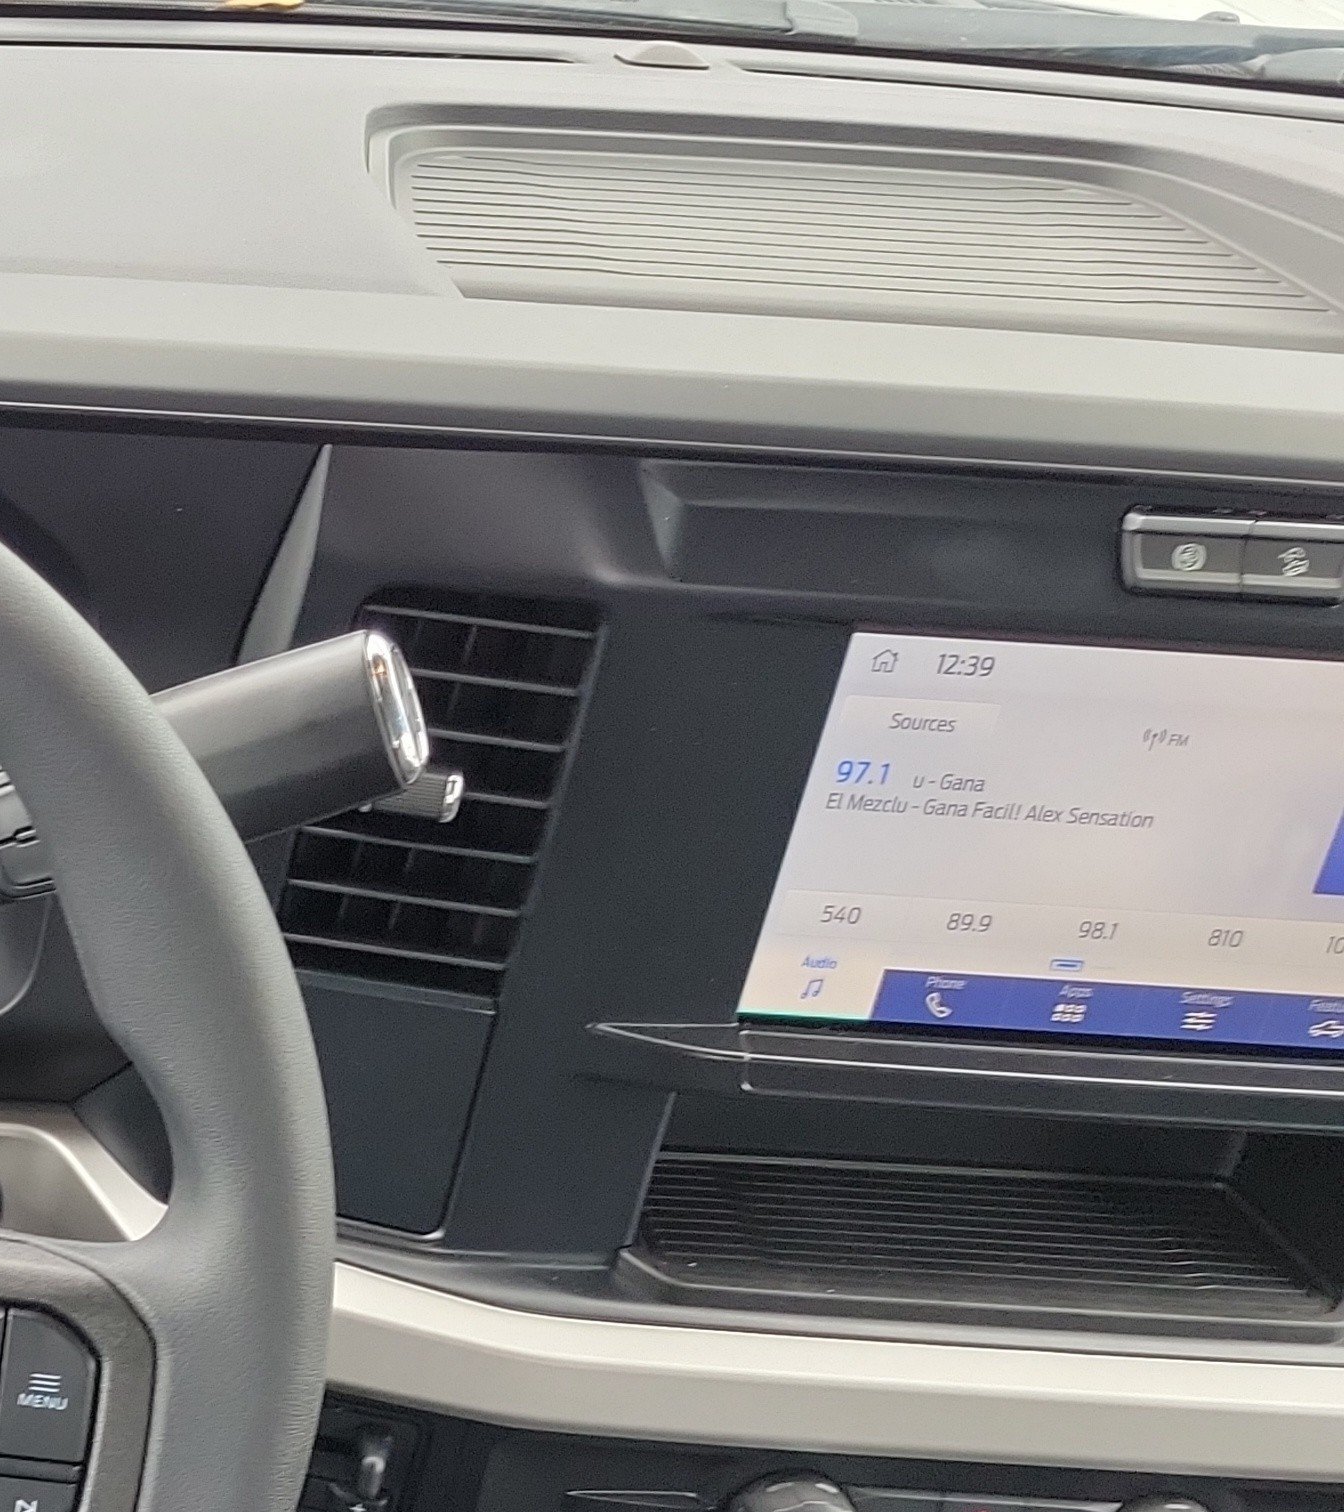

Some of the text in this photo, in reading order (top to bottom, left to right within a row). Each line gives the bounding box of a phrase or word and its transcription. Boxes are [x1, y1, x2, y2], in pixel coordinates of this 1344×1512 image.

[934, 653, 996, 678] 12:39
[888, 713, 957, 733] Sources
[1168, 733, 1190, 748] FM
[835, 760, 891, 786] 97.1
[939, 774, 985, 792] Gana
[825, 793, 843, 810] El
[922, 799, 968, 818] Gana
[1024, 805, 1062, 824] Alex
[1066, 807, 1155, 829] Sensation
[820, 904, 862, 925] 540
[946, 912, 993, 933] 89.9
[1078, 920, 1119, 941] 98.1
[1207, 928, 1245, 948] 810
[801, 954, 838, 970] Audio
[924, 975, 967, 991] Phone
[1059, 984, 1095, 999] Apps
[16, 1393, 69, 1411] MENU
